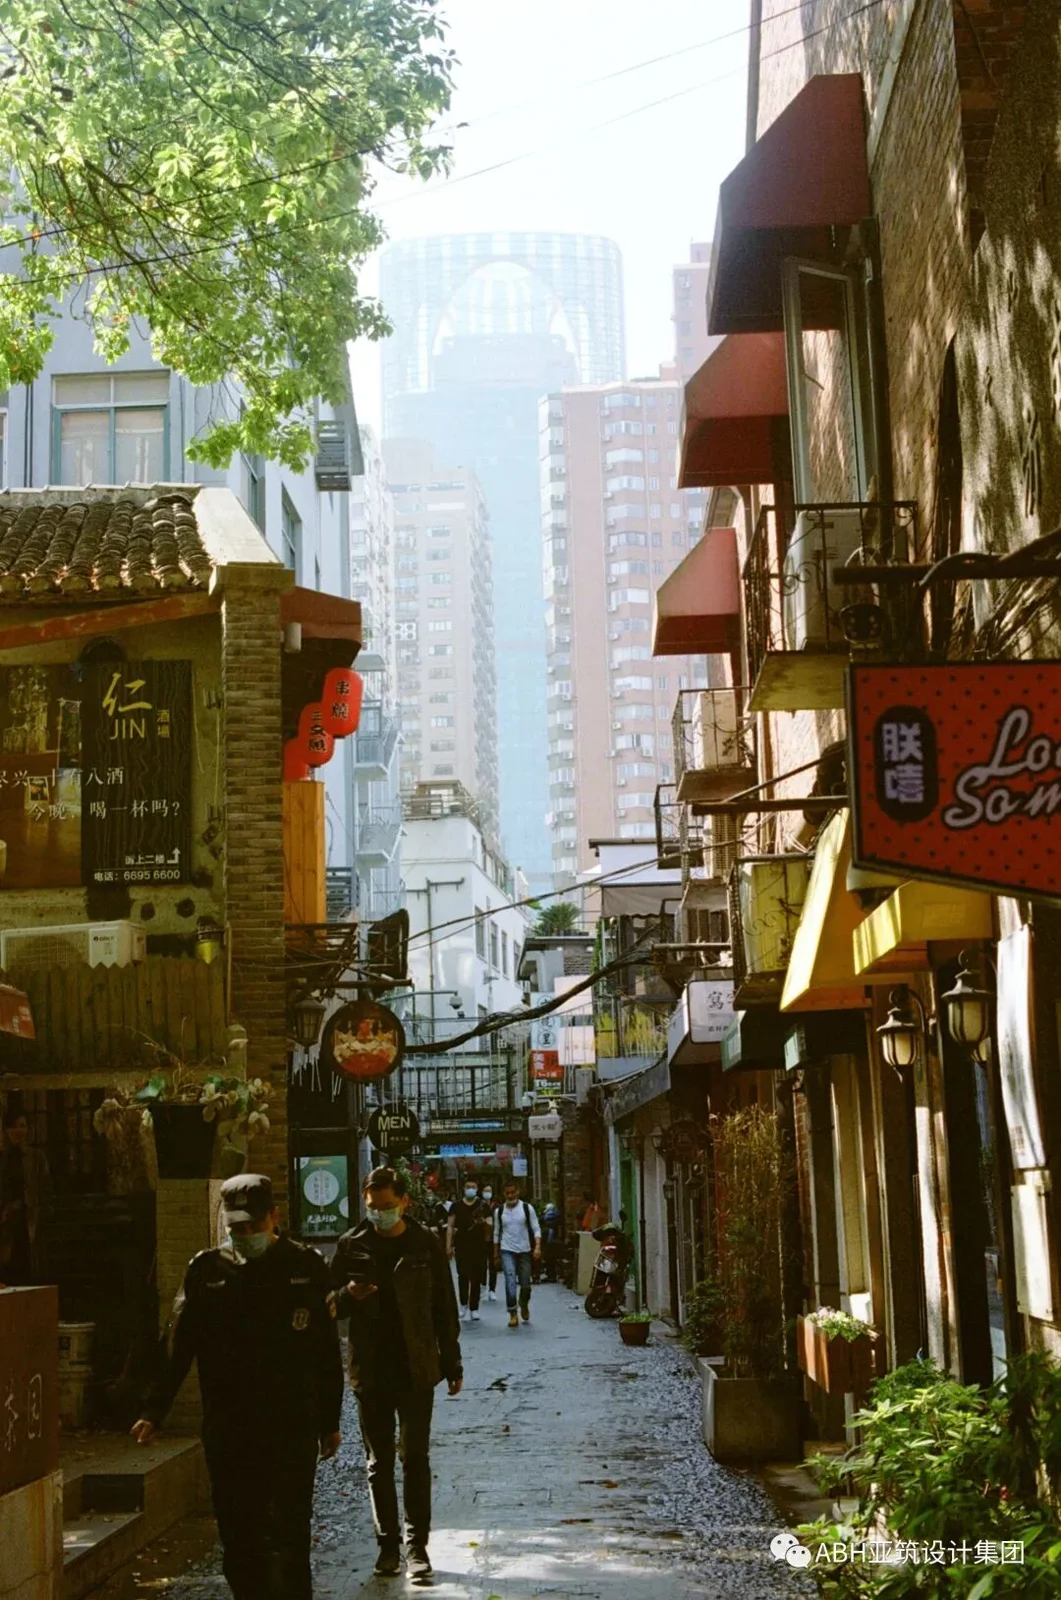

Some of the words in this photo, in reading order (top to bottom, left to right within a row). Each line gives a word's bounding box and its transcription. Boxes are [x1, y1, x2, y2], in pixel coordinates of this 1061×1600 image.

[102, 672, 153, 717] 仁
[110, 718, 146, 740] JIN
[988, 709, 1061, 778] Lo
[124, 870, 150, 881] 6695
[153, 869, 181, 880] 6600
[378, 1116, 411, 1131] MEN
